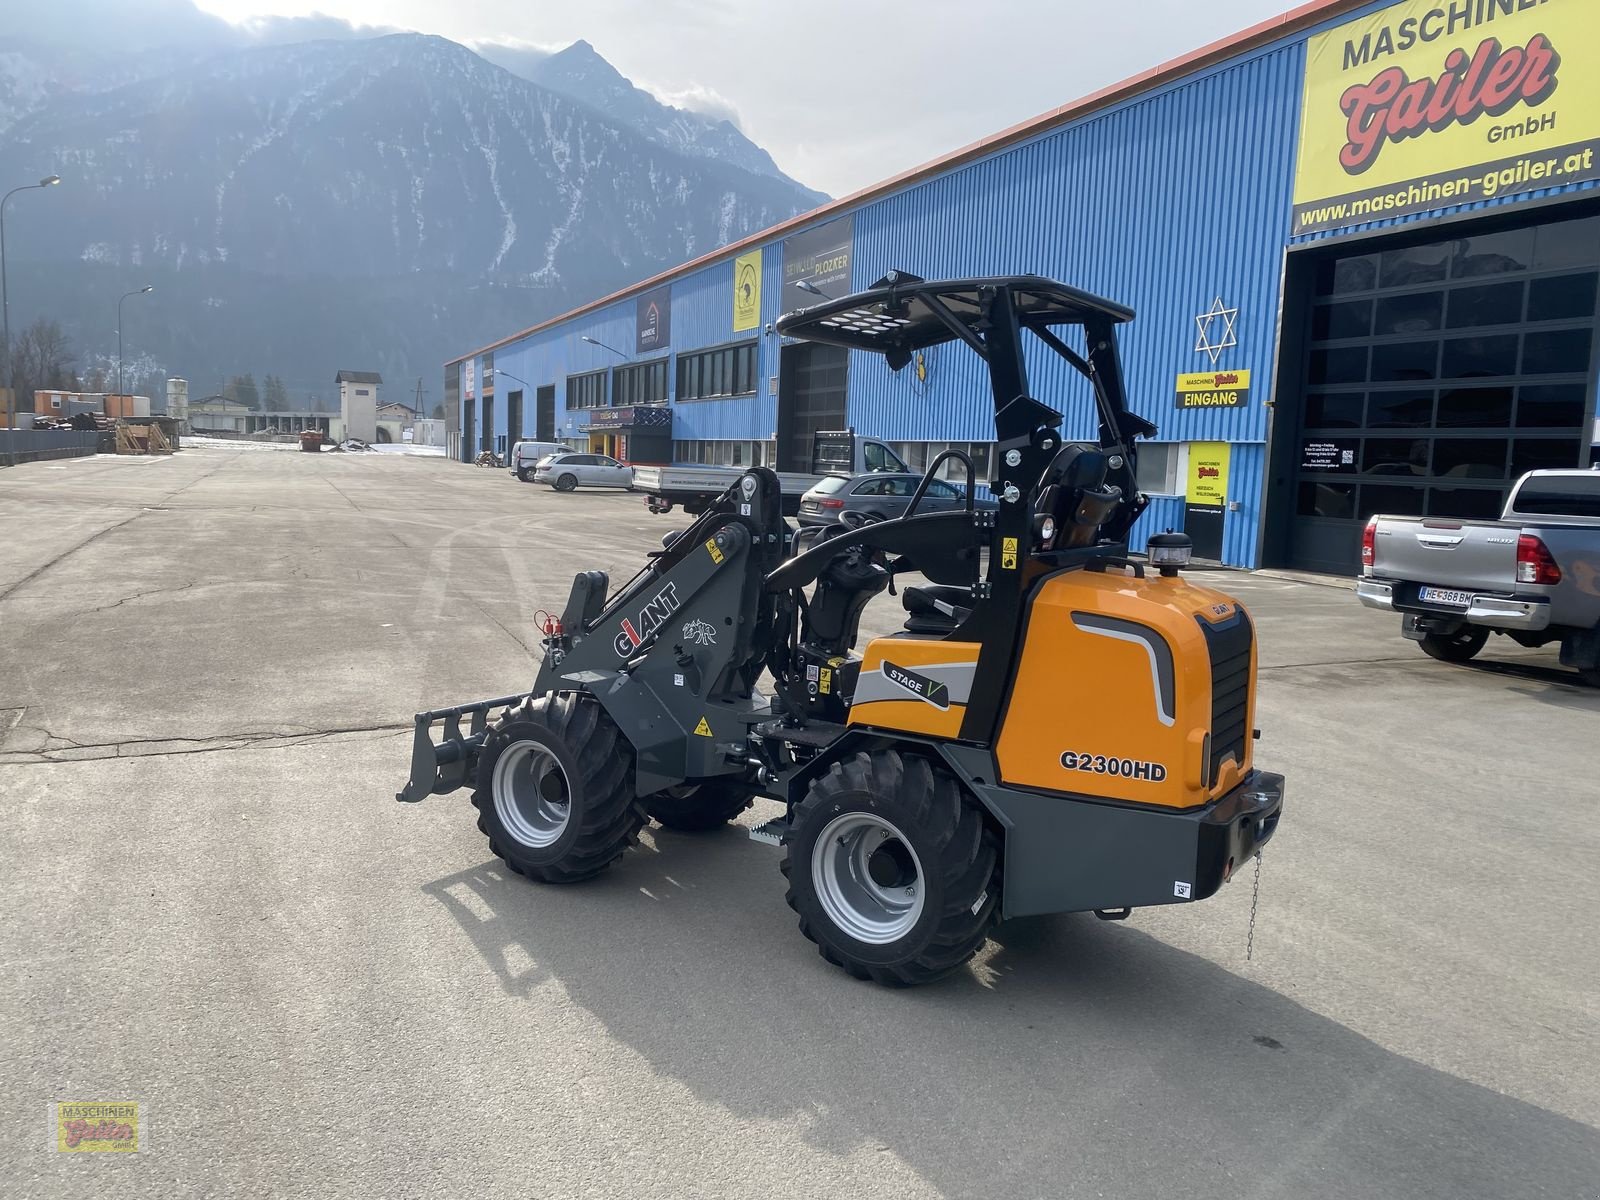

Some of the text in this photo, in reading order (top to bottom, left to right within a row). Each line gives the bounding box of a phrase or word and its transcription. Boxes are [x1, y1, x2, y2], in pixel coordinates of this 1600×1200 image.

[1339, 32, 1561, 175] Gailer
[1487, 112, 1556, 143] GmbH
[1301, 148, 1593, 226] www.maschinen-gailer.at
[1184, 391, 1238, 406] EINGANG
[613, 581, 680, 658] GIANT
[890, 669, 945, 697] STAGE V
[1060, 751, 1167, 782] G2300HD
